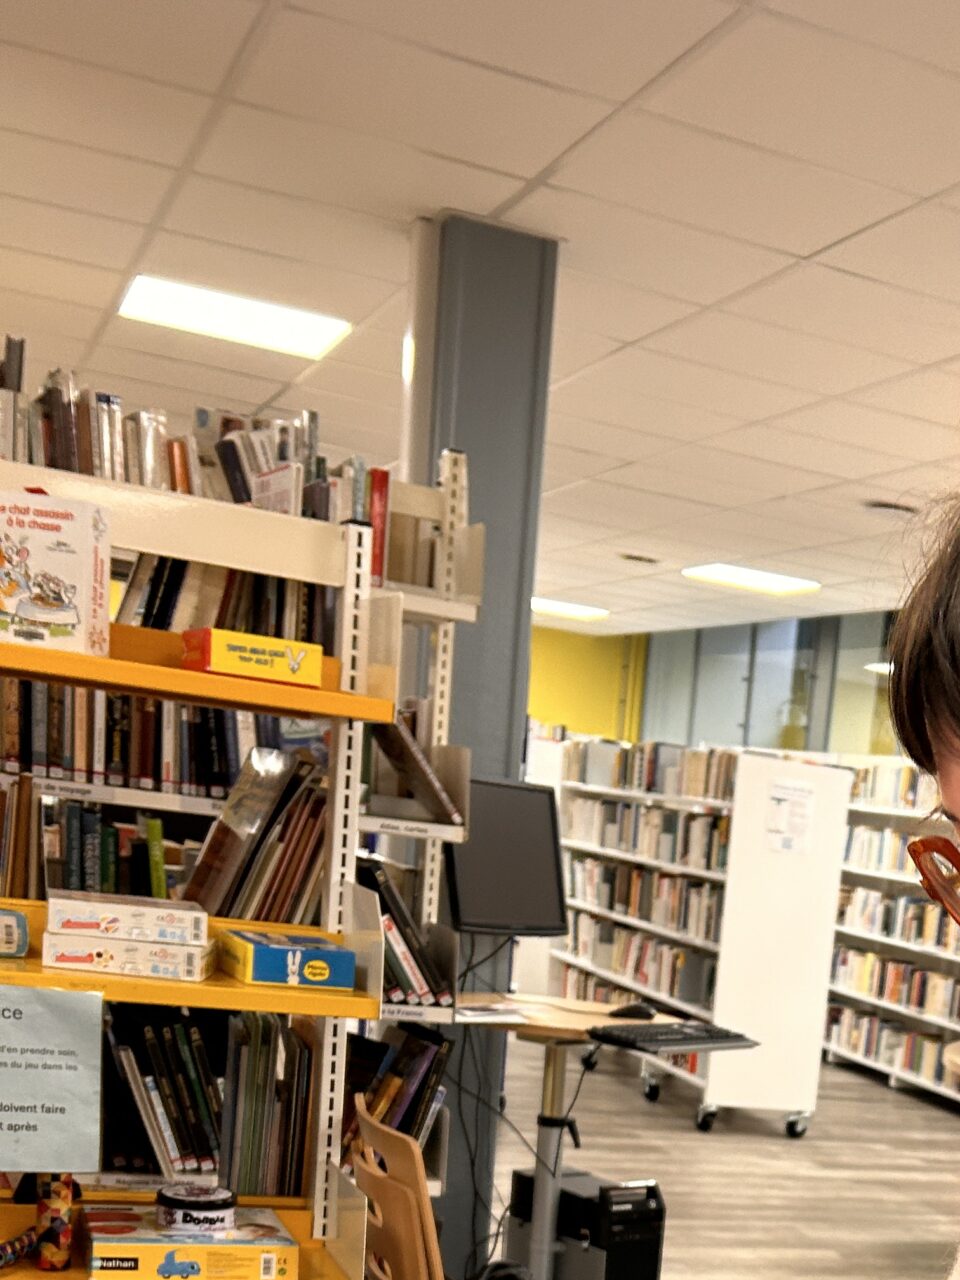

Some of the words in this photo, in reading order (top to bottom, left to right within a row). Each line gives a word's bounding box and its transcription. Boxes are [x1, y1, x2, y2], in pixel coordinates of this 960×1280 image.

[9, 504, 30, 516] chat
[33, 508, 74, 521] assassin
[16, 517, 25, 528] la
[28, 519, 61, 532] chasse
[20, 1046, 54, 1056] prendre
[10, 1060, 22, 1069] du
[25, 1061, 38, 1071] jeu
[41, 1062, 62, 1071] dans
[41, 1103, 66, 1115] faire
[7, 1121, 38, 1133] après
[99, 1258, 135, 1269] Nathan
